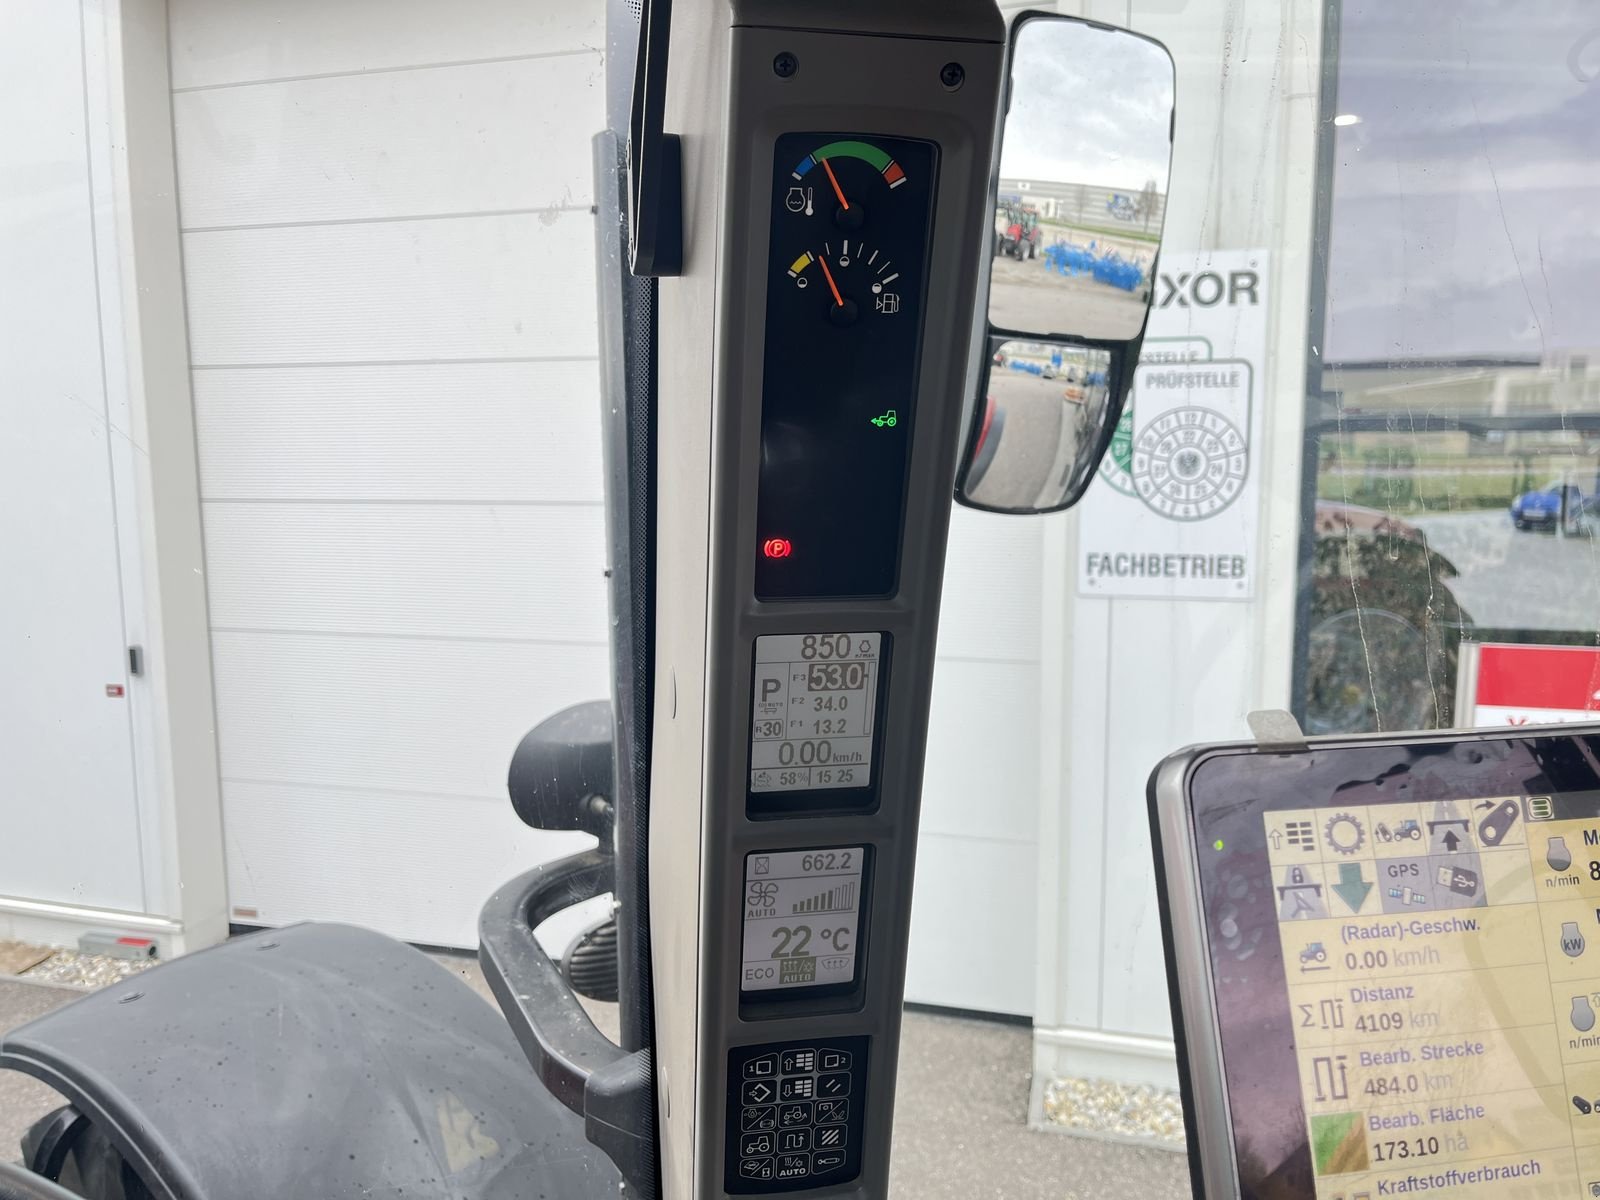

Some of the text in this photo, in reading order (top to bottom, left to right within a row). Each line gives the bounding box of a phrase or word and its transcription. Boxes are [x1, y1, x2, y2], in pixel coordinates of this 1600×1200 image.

[1150, 270, 1259, 308] XOR
[1145, 370, 1240, 389] PRÜFSTELLE
[1086, 552, 1246, 579] FACHBETRIEB
[801, 634, 851, 659] 850
[809, 663, 863, 690] 53.0
[762, 679, 781, 702] P
[814, 696, 848, 712] 34.0
[813, 719, 847, 735] 13.2
[778, 740, 862, 766] 0.00 km/h
[1583, 829, 1600, 846] M
[802, 852, 851, 872] 662.2
[1387, 863, 1420, 878] GPS
[1545, 874, 1580, 888] n/min
[747, 909, 776, 918] AUTO
[771, 925, 850, 958] 22 °C
[1341, 917, 1480, 945] (Radar)-Geschw.
[1563, 938, 1581, 951] kW
[1345, 945, 1440, 970] 0.00 km/h
[745, 968, 775, 981] ECO
[783, 973, 811, 983] AUTO
[1349, 986, 1415, 1004] Distanz
[1355, 1011, 1439, 1033] 4109 km
[1360, 1041, 1484, 1067] Bearb. Strecke
[1364, 1072, 1453, 1096] 484.0 km
[1369, 1104, 1485, 1131] Bearb. Fläche
[1373, 1133, 1469, 1162] 173.10 ha
[779, 1168, 806, 1177] AUTO
[1378, 1159, 1541, 1196] Kraftstoffverbrauch
